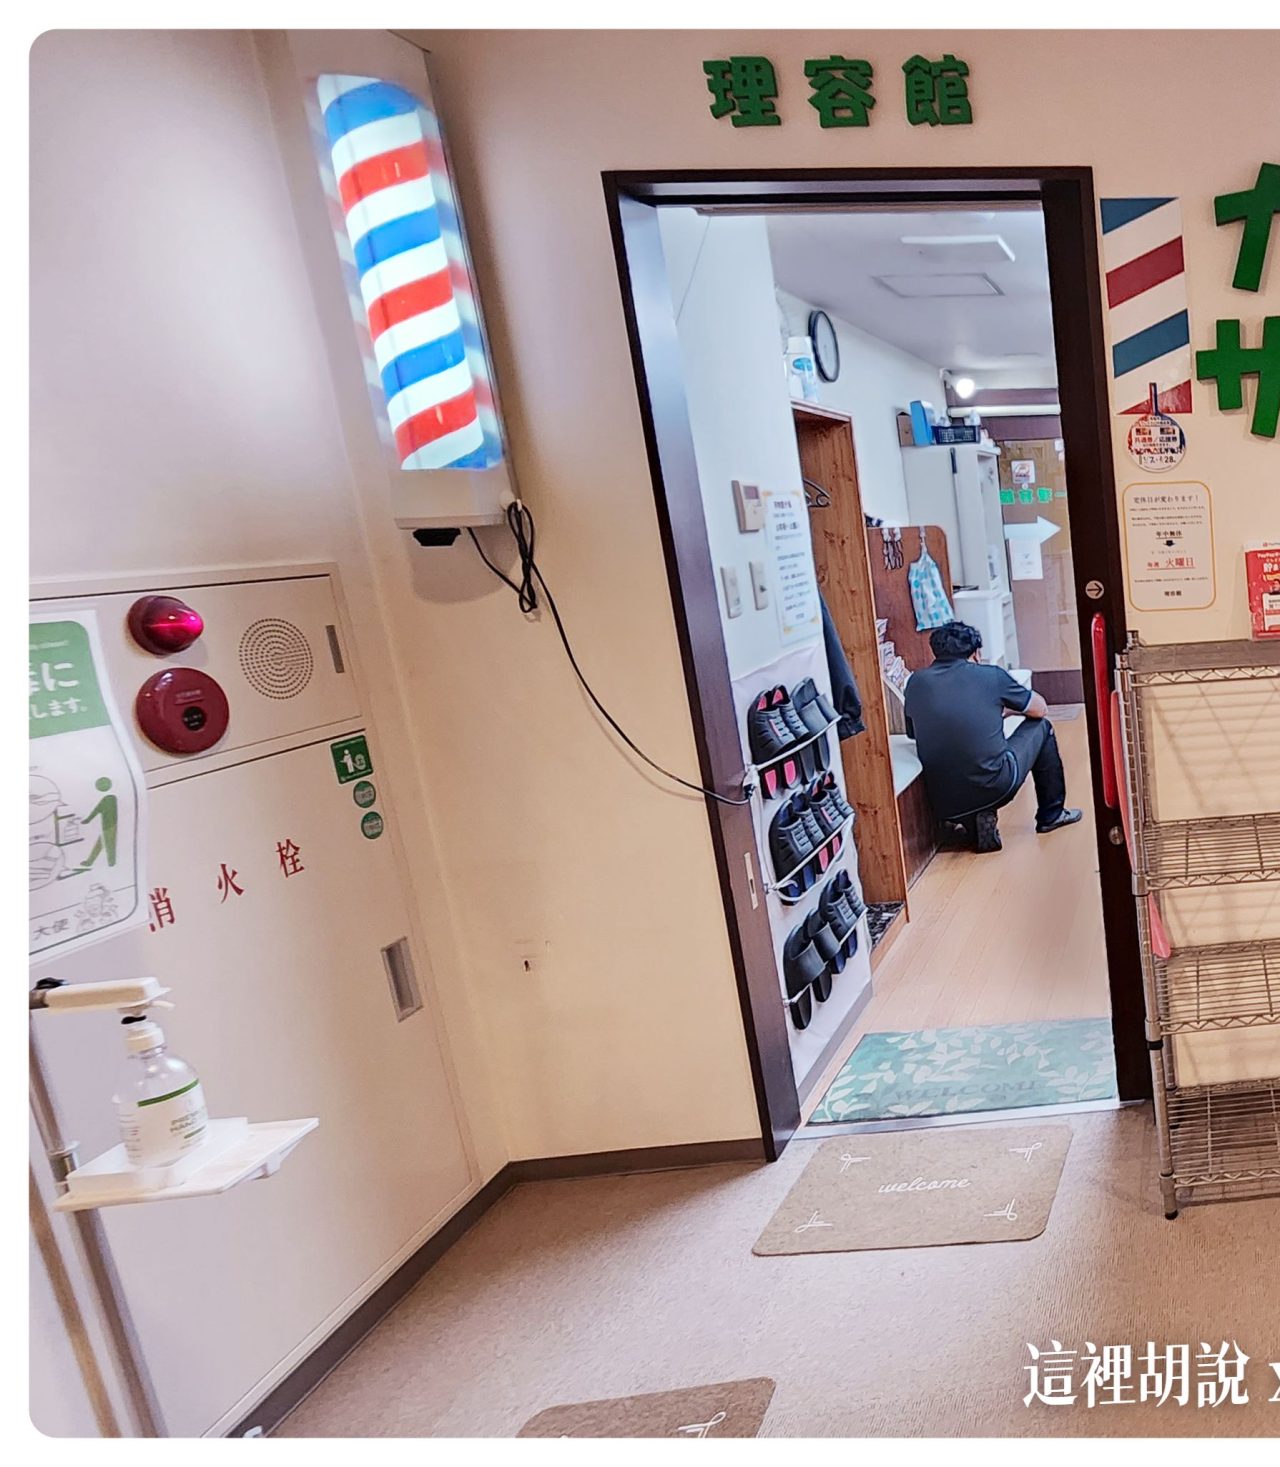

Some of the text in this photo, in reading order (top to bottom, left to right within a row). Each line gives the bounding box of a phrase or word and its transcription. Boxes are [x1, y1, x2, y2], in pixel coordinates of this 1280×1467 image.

[702, 54, 973, 128] 理容館
[1165, 557, 1195, 568] 火曜日
[879, 1176, 972, 1193] welcome
